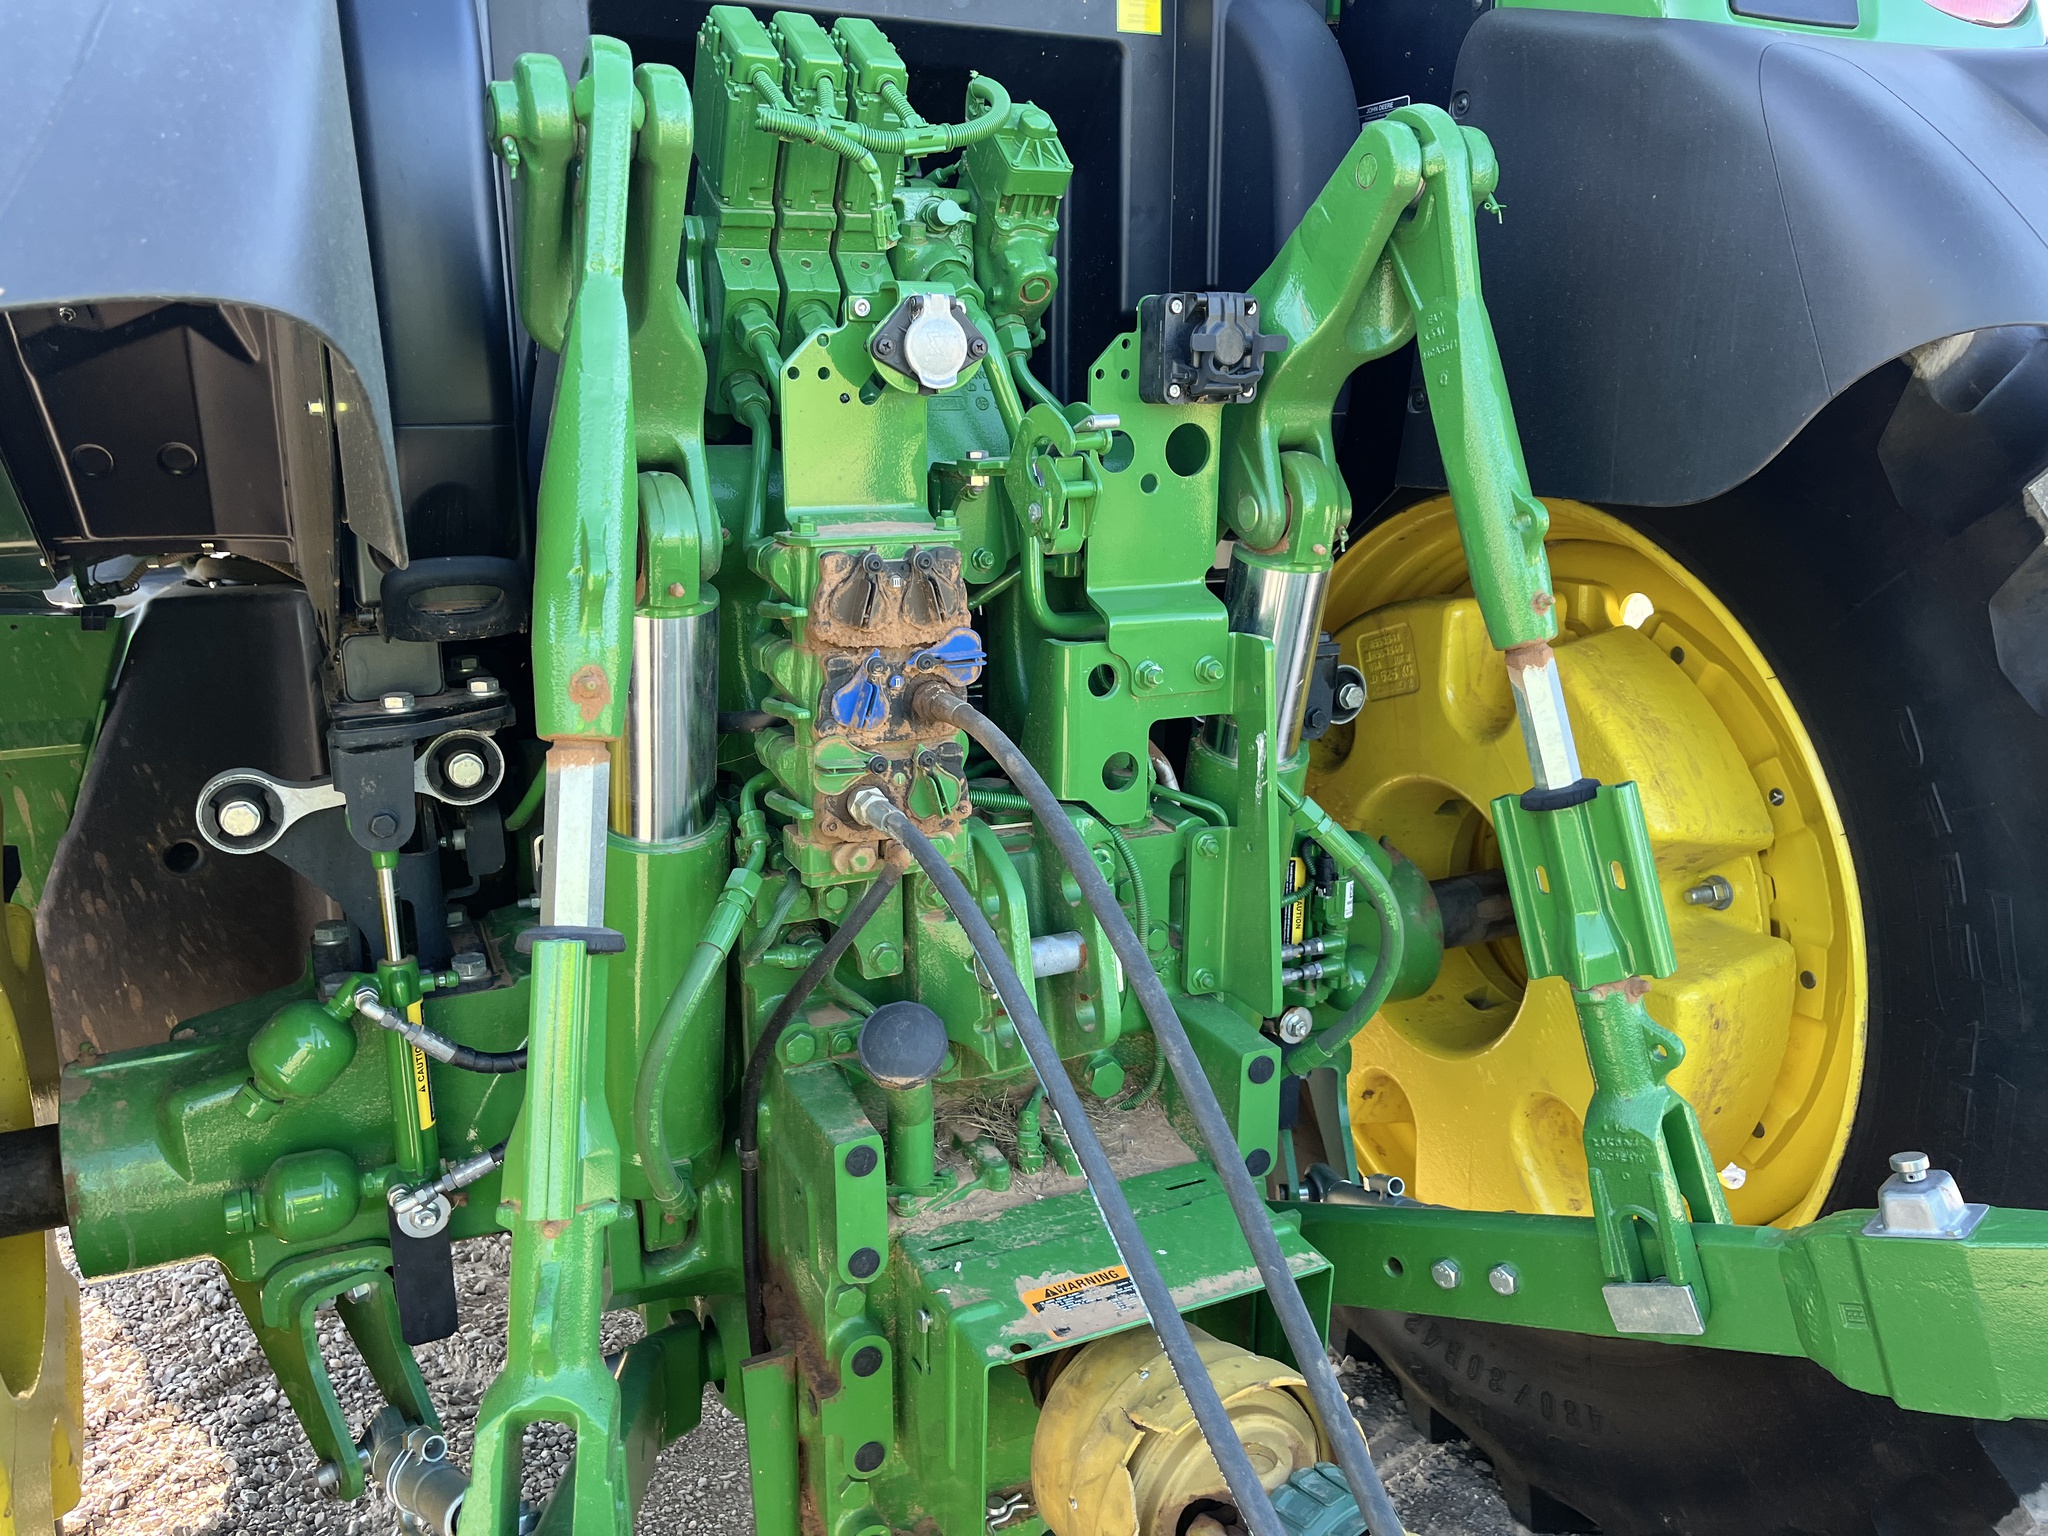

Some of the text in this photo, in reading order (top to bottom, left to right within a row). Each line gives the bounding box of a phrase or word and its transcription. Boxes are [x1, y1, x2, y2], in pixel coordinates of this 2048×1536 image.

[1366, 101, 1394, 114] JOHN DEERE
[1295, 901, 1303, 930] AUTION
[414, 1047, 426, 1082] CAUTIO
[1054, 1269, 1120, 1294] WARNING
